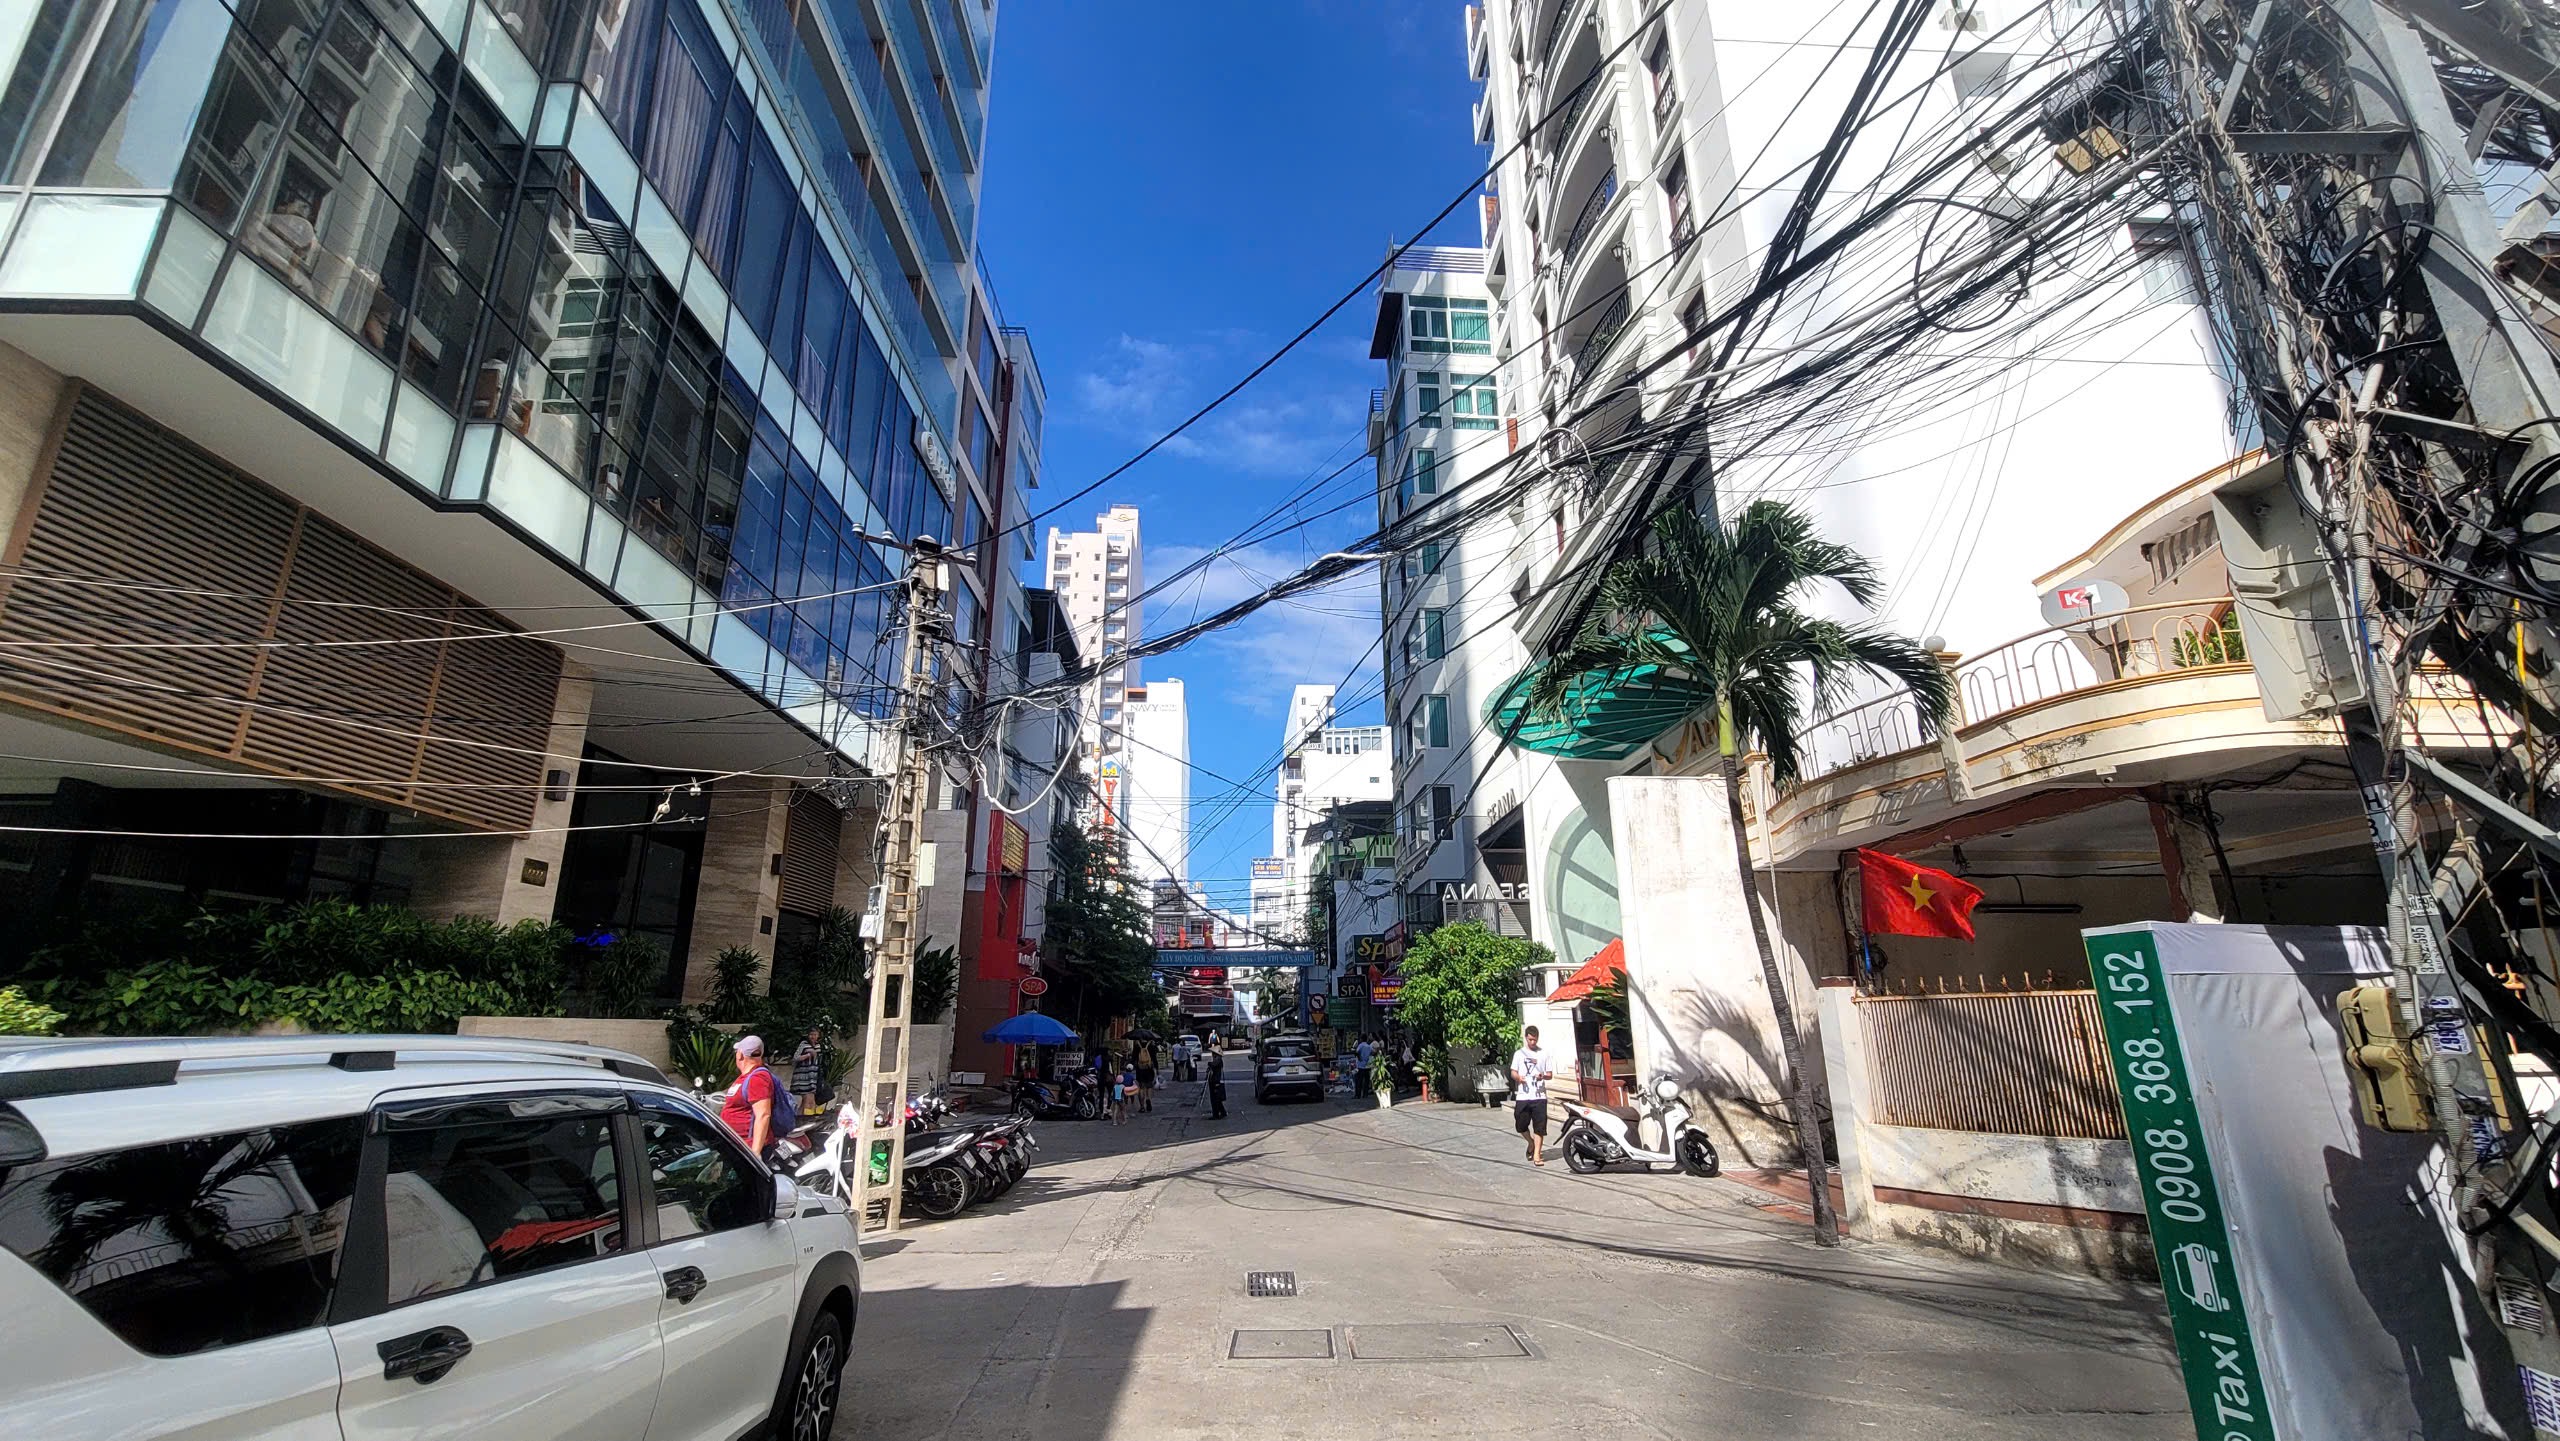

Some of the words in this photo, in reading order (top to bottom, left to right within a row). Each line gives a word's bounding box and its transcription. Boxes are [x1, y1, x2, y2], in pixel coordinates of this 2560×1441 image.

[1358, 937, 1386, 960] Sp
[1025, 981, 1043, 991] SPA
[1341, 985, 1364, 997] SPA
[2103, 950, 2154, 1015] 152
[2123, 1028, 2177, 1104] 368.
[2144, 1119, 2206, 1222] 0908.
[2199, 1330, 2254, 1426] Taxi
